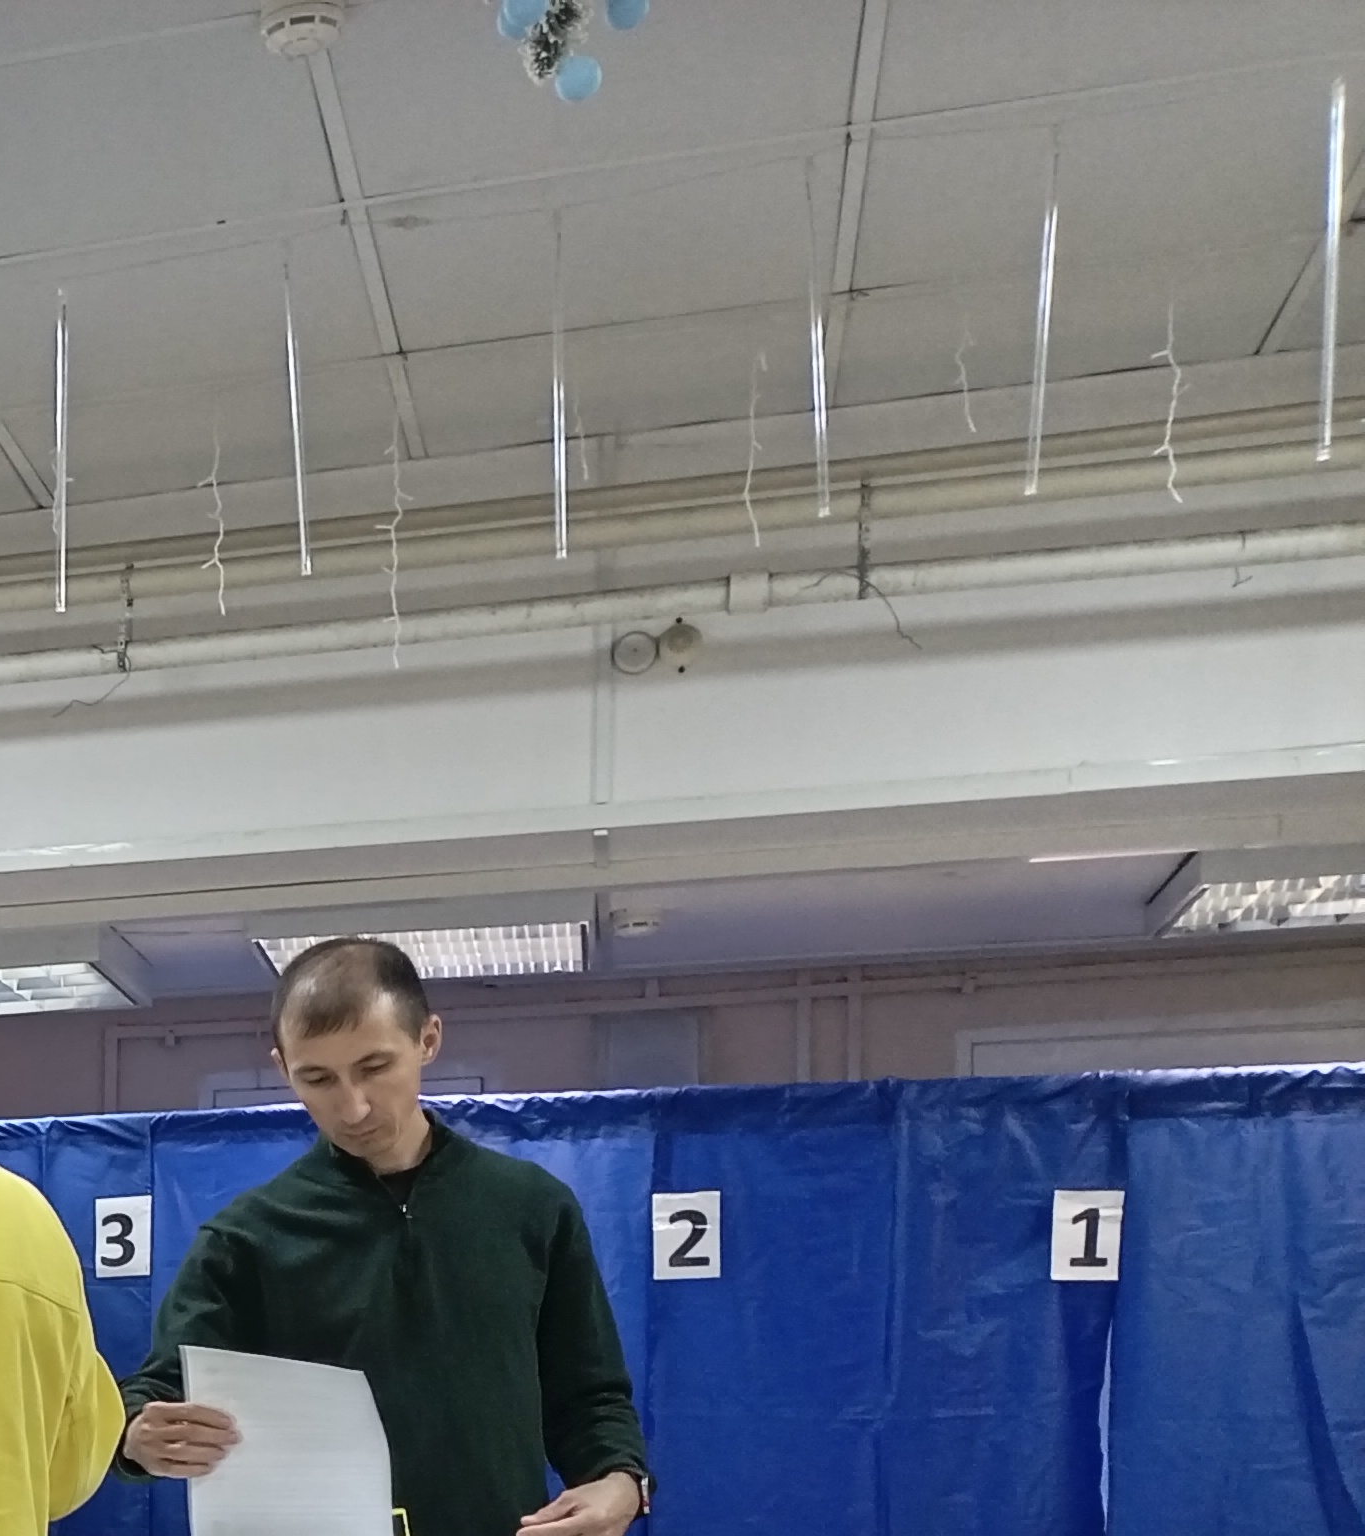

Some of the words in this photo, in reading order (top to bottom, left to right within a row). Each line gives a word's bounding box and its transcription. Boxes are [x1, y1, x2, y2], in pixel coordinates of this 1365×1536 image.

[100, 1213, 136, 1268] 3
[669, 1209, 710, 1267] 2
[1069, 1207, 1108, 1267] 1
